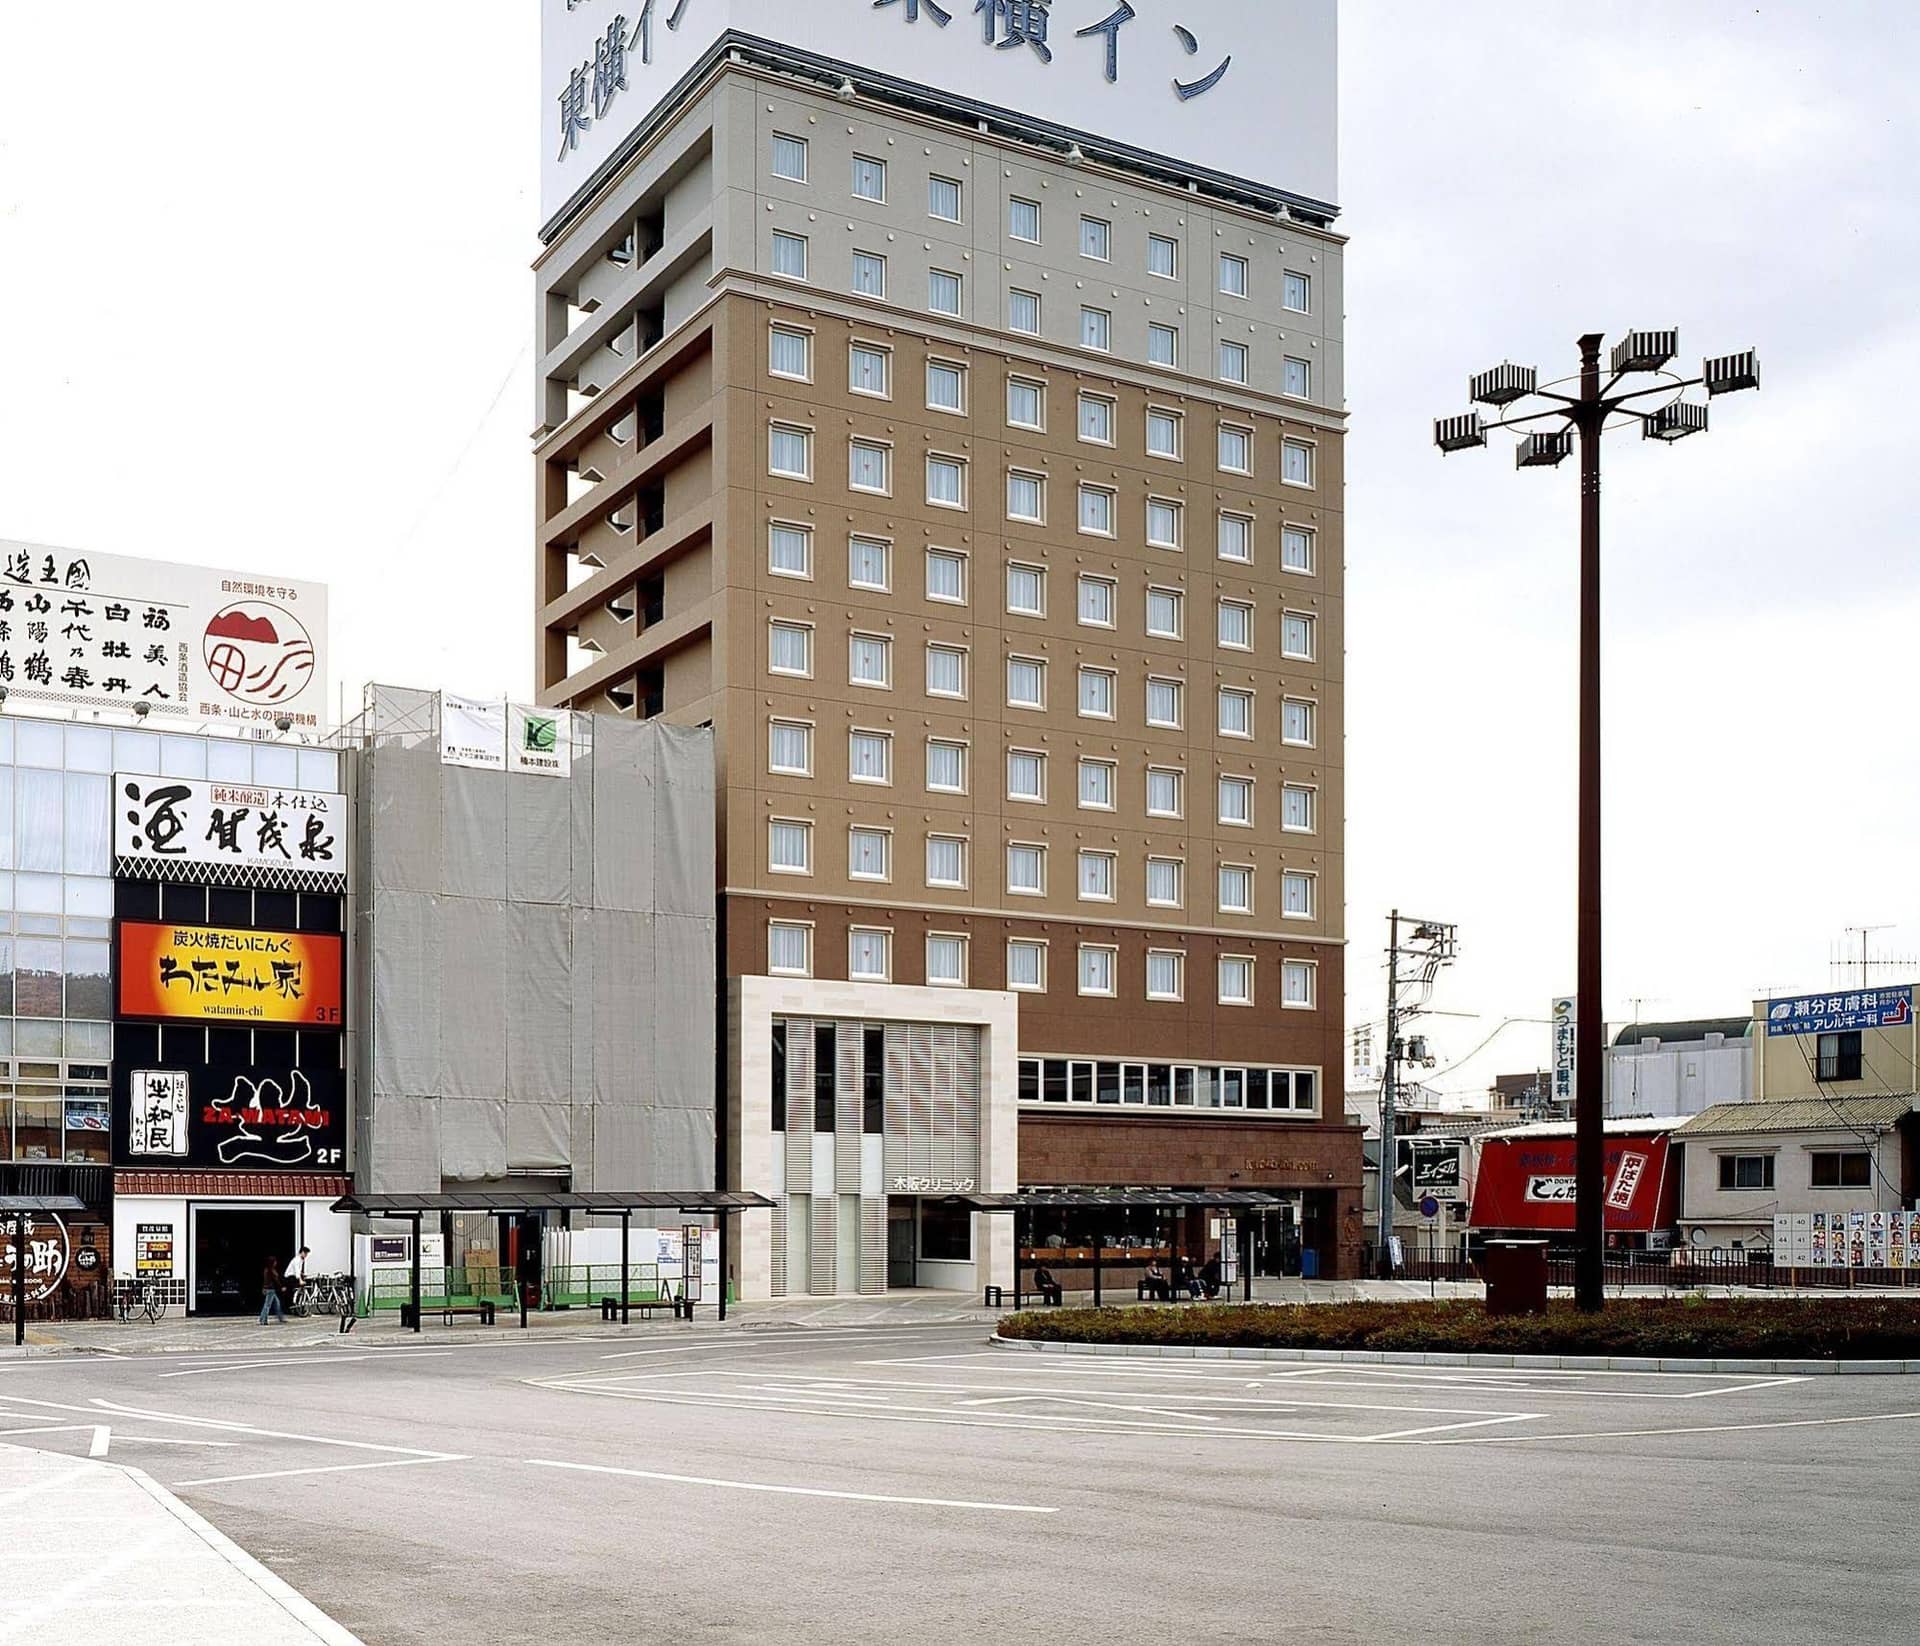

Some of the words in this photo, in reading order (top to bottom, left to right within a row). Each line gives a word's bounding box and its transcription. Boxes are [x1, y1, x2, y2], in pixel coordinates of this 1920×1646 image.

[873, 0, 1231, 100] 横イン
[558, 0, 691, 162] 東横イ
[220, 579, 298, 600] 自然環境を守る
[271, 791, 328, 813] 本仕込
[173, 930, 292, 953] 炭火焼だいにんぐ
[316, 1006, 339, 1021] 3F
[1813, 1014, 1877, 1030] アレルギー科
[316, 1149, 341, 1163] 2F
